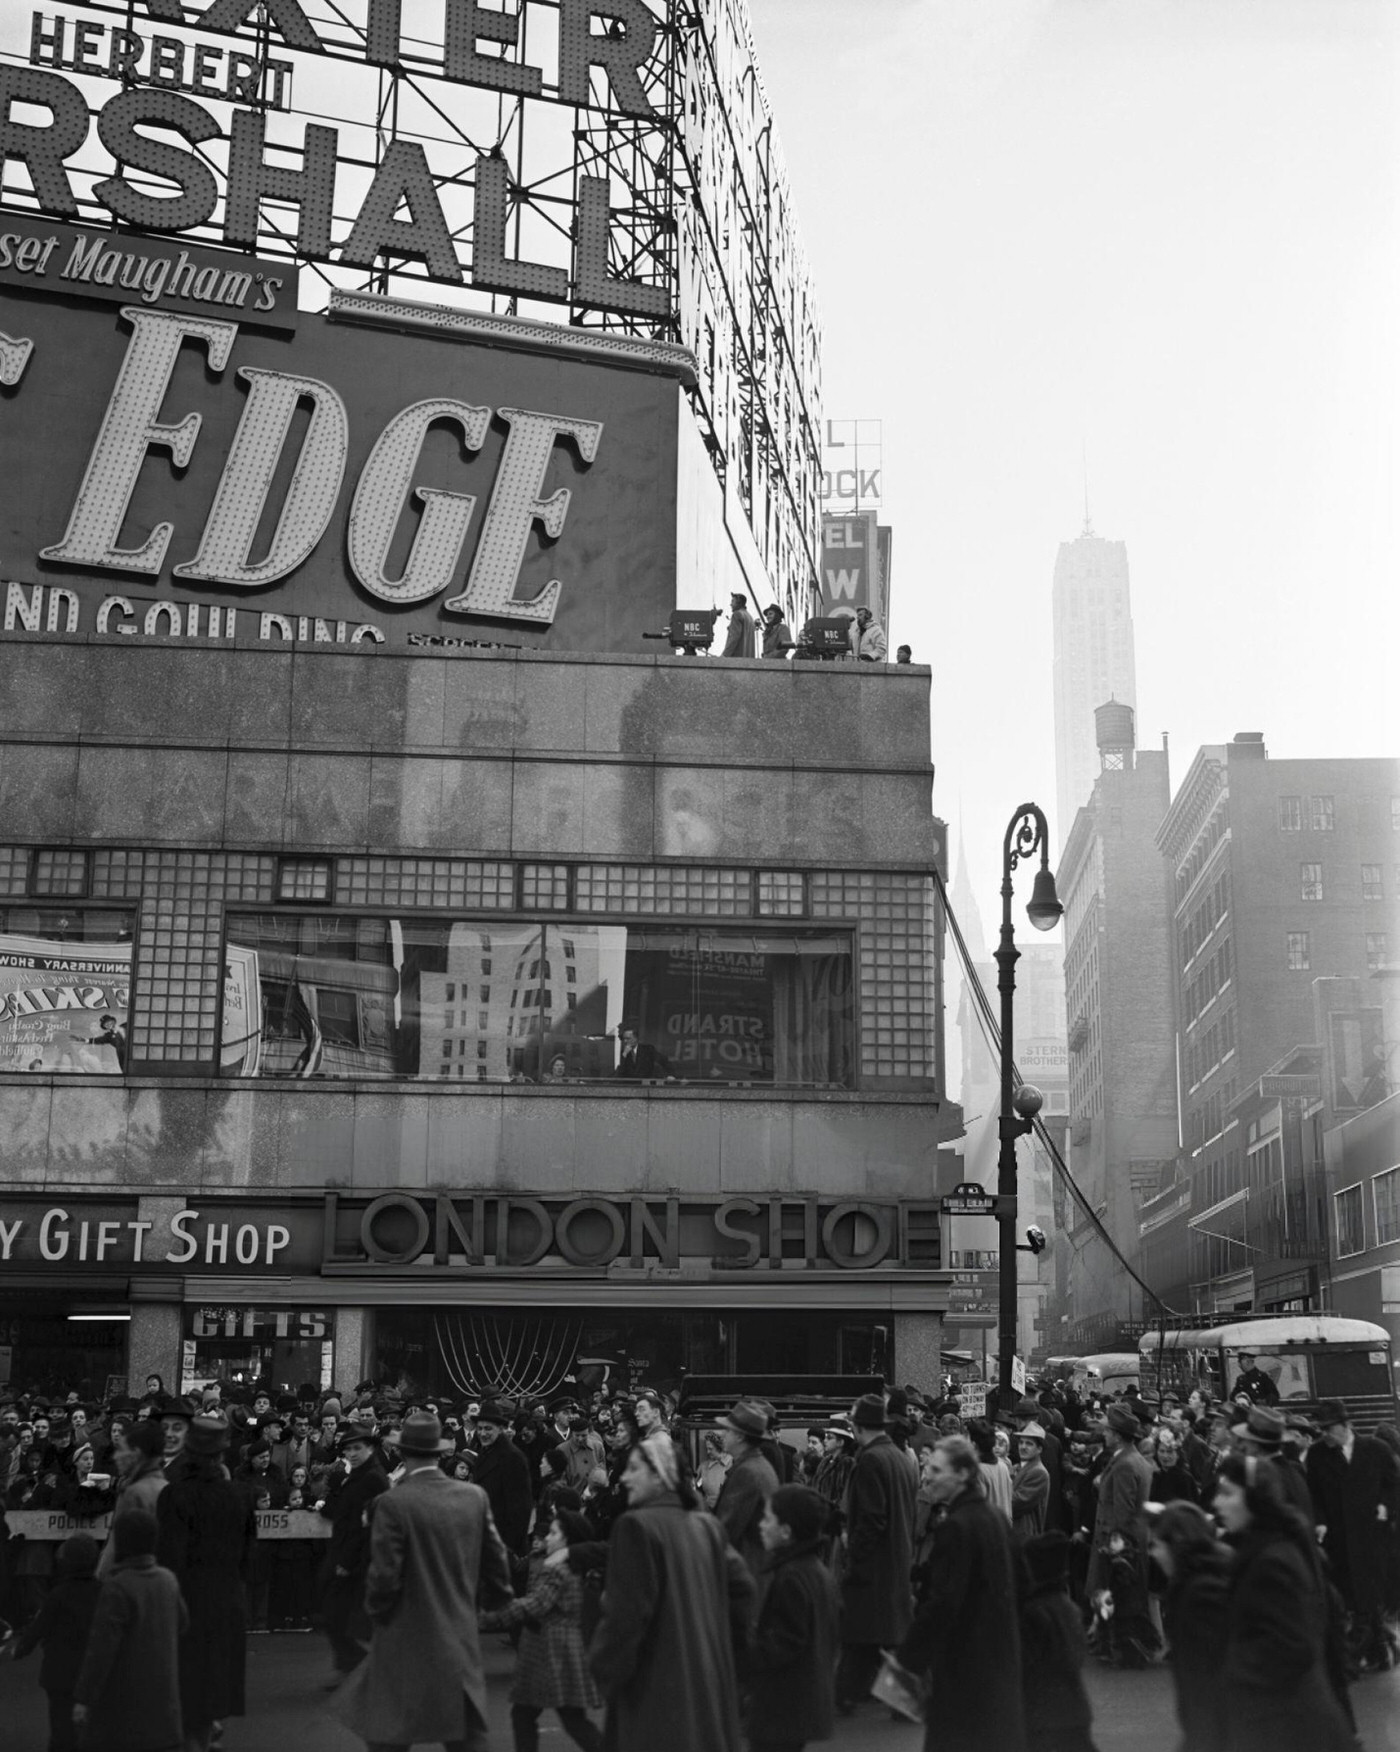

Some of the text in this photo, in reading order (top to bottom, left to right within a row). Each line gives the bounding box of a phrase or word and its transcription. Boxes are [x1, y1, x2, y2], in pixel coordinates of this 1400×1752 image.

[29, 11, 294, 113] HERBERT
[60, 234, 283, 311] Maugham's
[39, 306, 603, 625] EDGE
[684, 622, 700, 632] NBC
[40, 1208, 152, 1262] GIFT
[165, 1210, 290, 1265] SHOP
[325, 1191, 941, 1269] LONDON SHOE
[193, 1311, 326, 1338] GIFTS
[48, 1513, 97, 1530] POLICE
